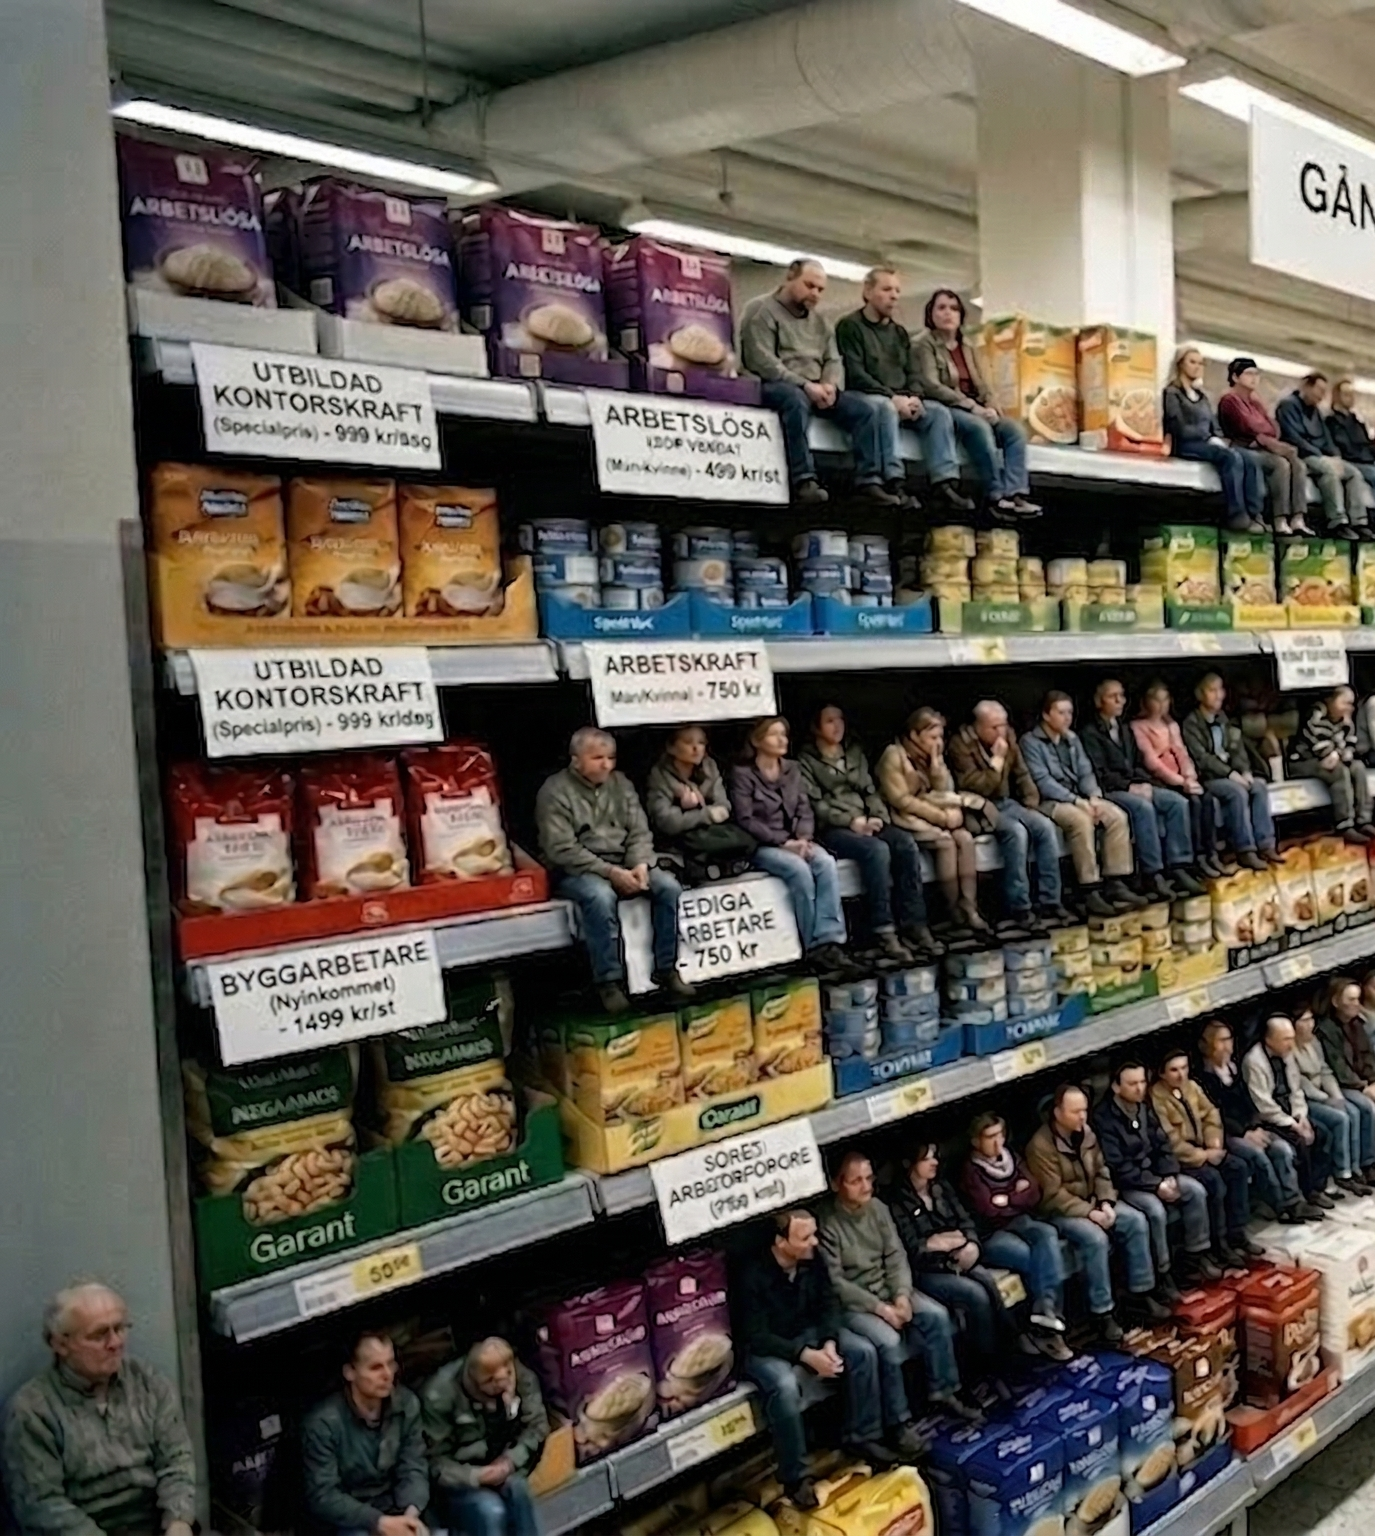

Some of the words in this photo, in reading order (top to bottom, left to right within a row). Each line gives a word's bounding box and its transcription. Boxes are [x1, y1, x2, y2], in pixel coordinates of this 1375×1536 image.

[253, 361, 383, 395] UTBILDAD
[213, 384, 422, 425] KONTORSKRAFT
[334, 423, 370, 443] 999
[605, 404, 772, 442] ARBETSLÖSA
[254, 657, 383, 681] UTBILDAD
[606, 652, 759, 675] ARBETSKRAFT
[215, 682, 425, 710] KONTORSKRAFT
[707, 680, 740, 699] 750
[743, 679, 762, 697] kr
[213, 715, 321, 741] (Specialpris)
[337, 712, 372, 731] 999
[682, 891, 752, 919] EDIGA
[220, 940, 430, 997] BYGGARBETARE
[694, 944, 732, 969] 750
[739, 941, 760, 960] kr
[269, 974, 396, 1017] (Nyinkommet)
[294, 1009, 344, 1036] 1499
[350, 1000, 396, 1022] kr/st
[441, 1158, 532, 1205] Garant
[249, 1210, 357, 1264] Garant
